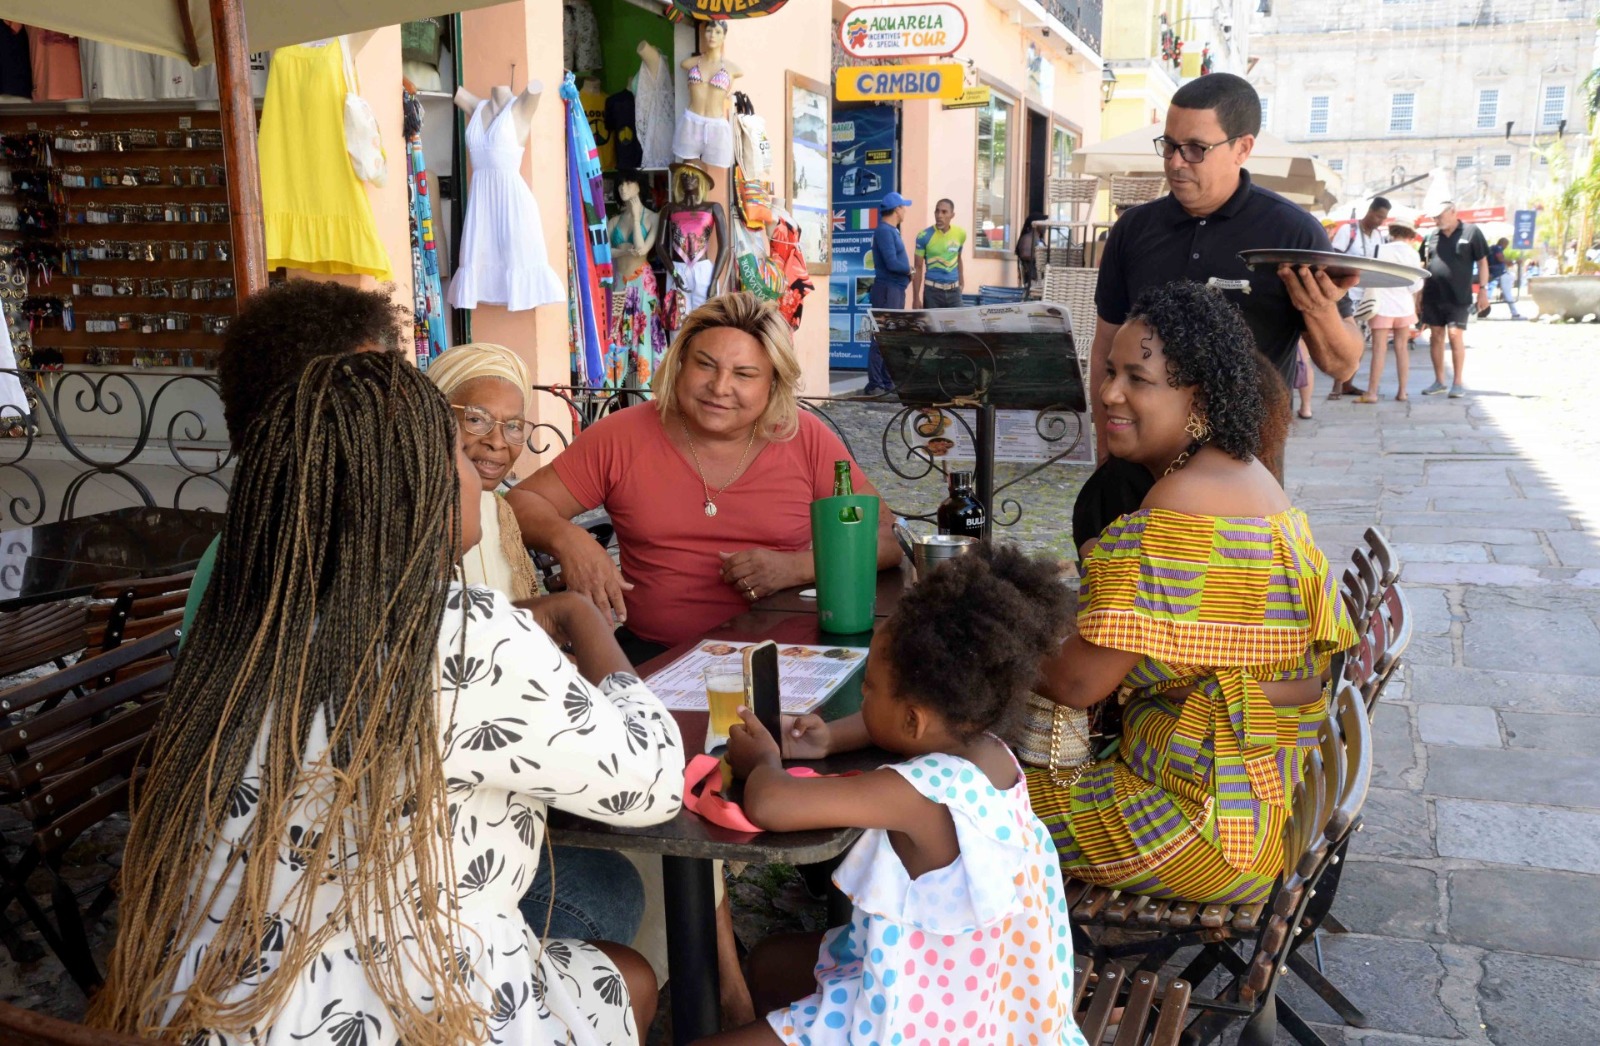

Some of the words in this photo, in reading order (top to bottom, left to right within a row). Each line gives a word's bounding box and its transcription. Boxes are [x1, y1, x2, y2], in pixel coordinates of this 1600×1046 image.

[869, 14, 944, 31] AQUARELA
[867, 32, 901, 40] INCENTIVES
[902, 31, 947, 47] TOUR
[856, 71, 941, 94] CAMBIO
